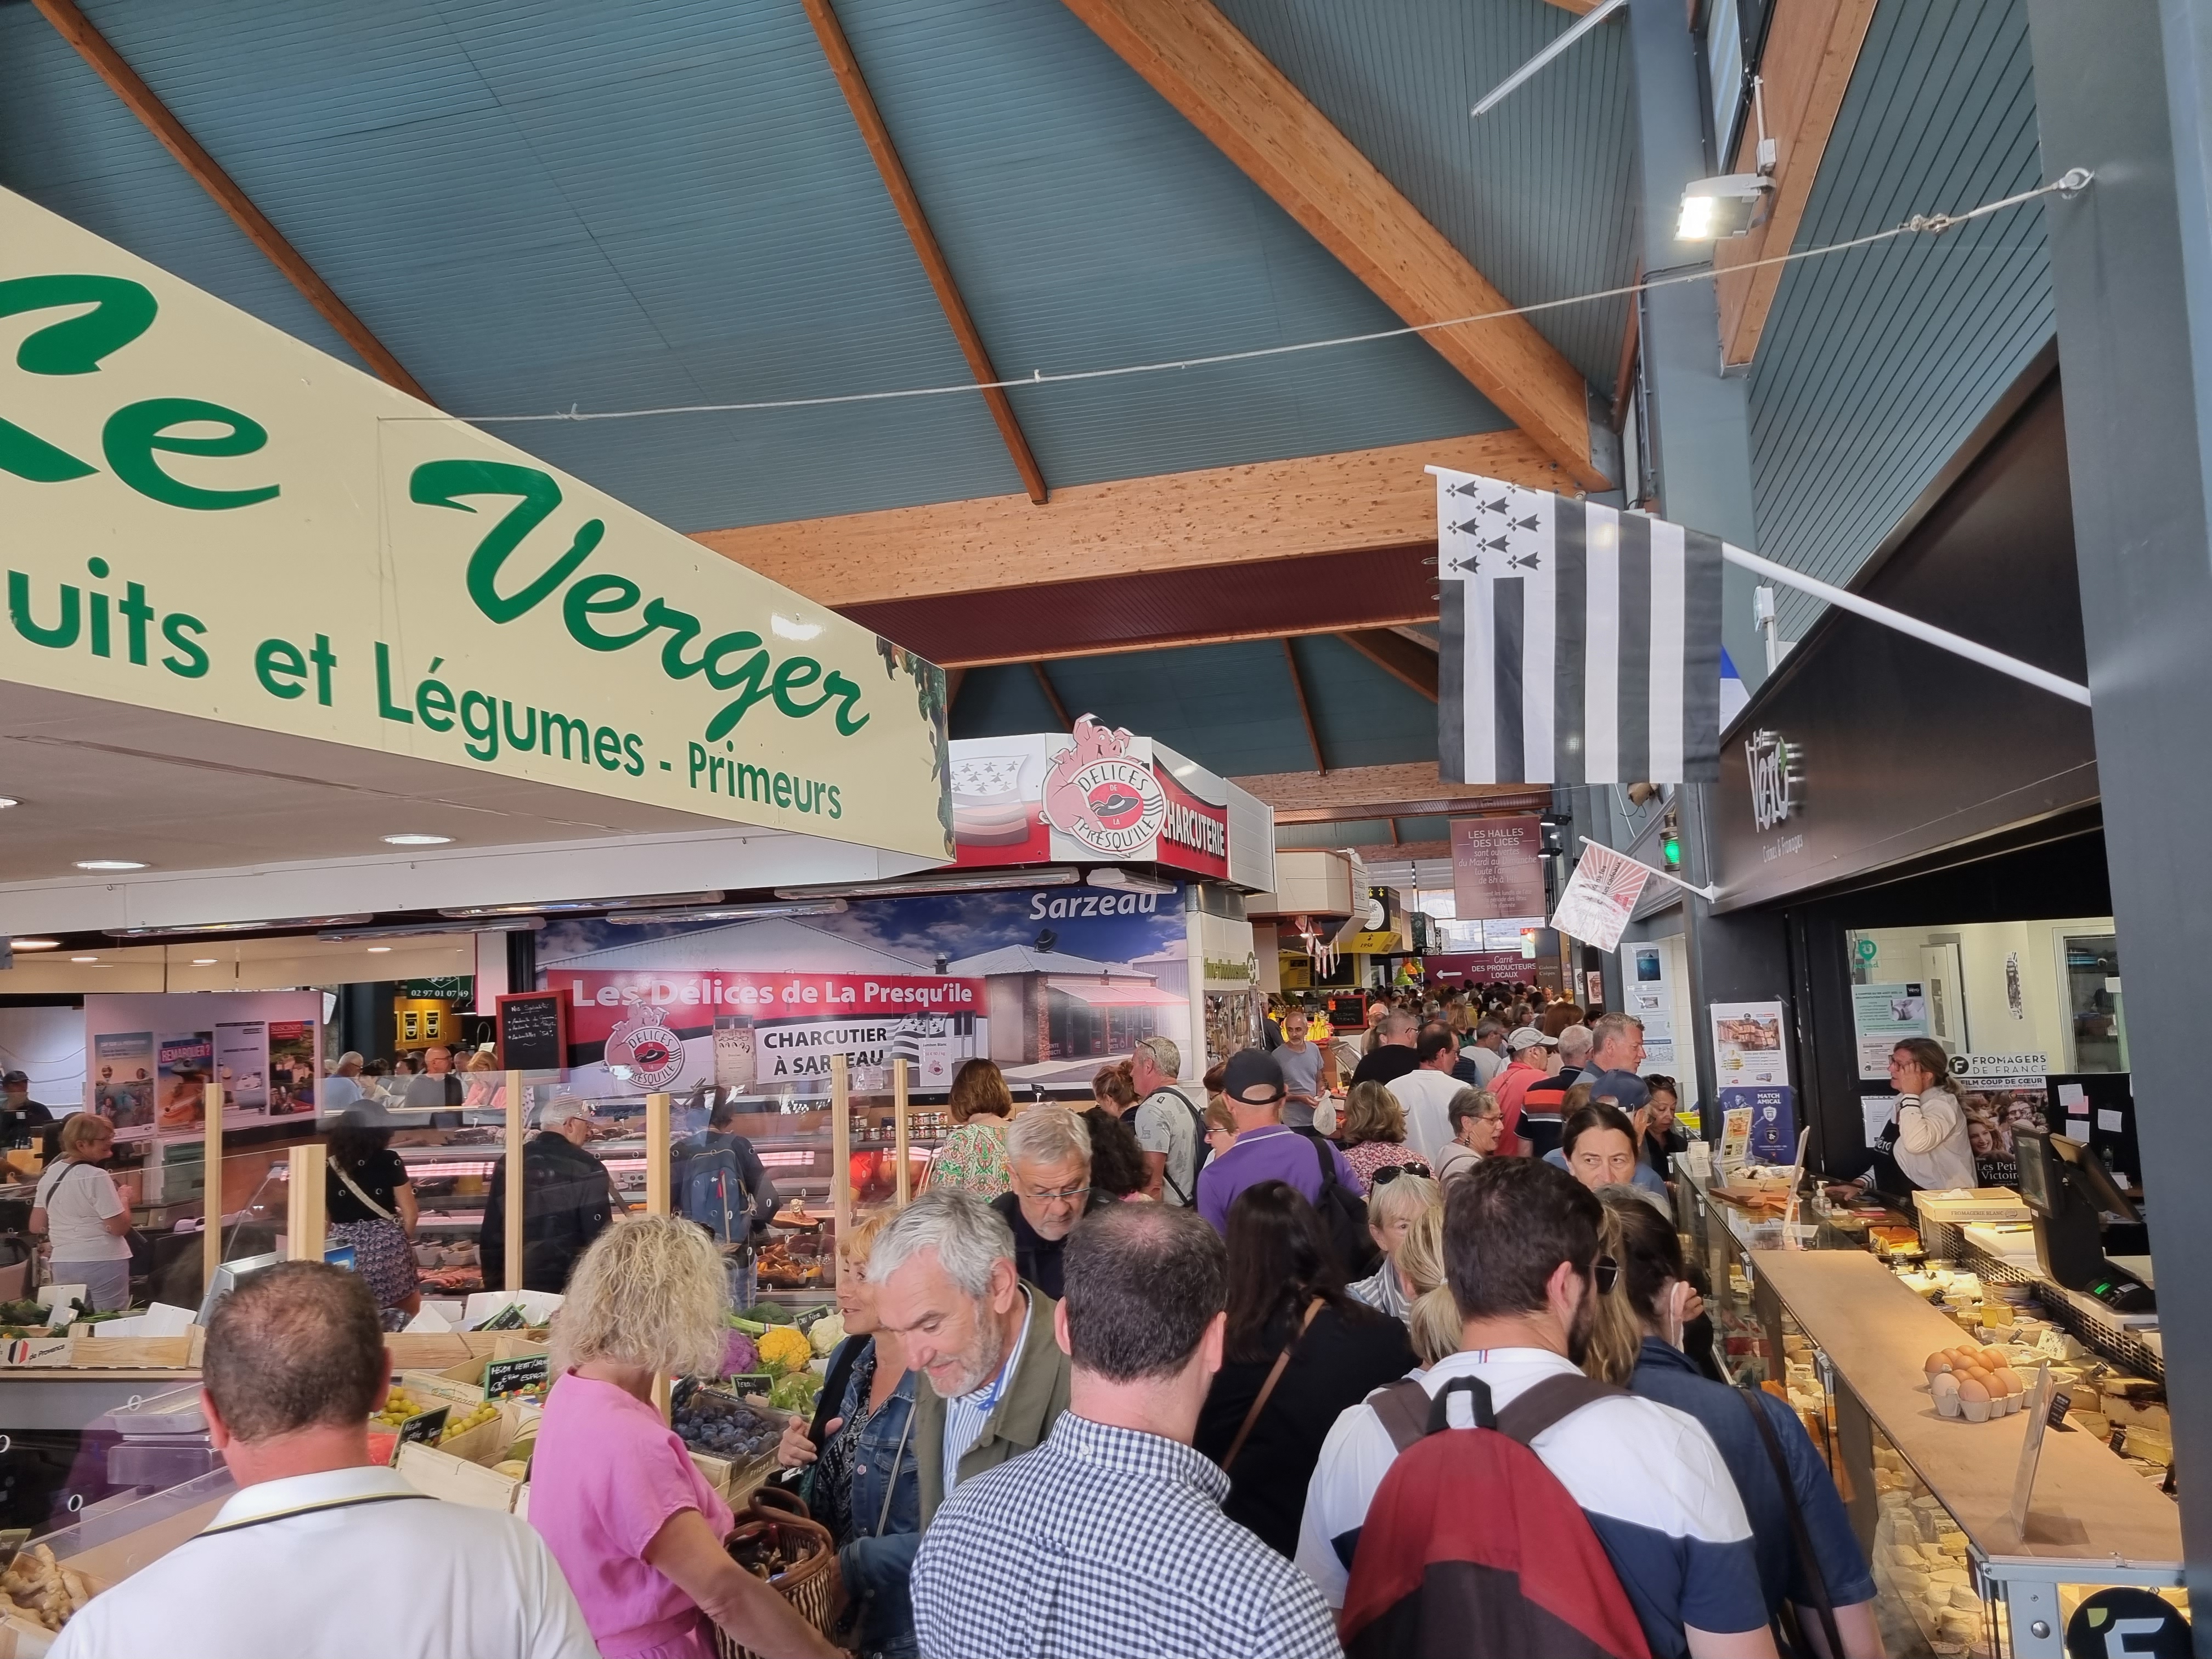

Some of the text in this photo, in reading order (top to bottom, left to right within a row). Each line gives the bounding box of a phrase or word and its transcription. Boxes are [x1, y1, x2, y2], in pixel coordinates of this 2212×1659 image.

[409, 459, 870, 742] Verger
[254, 633, 338, 707] et
[374, 641, 645, 777] Légumes
[687, 740, 843, 820] Primeurs
[1468, 828, 1524, 839] LES HALLES
[1473, 837, 1520, 848] DES LICES
[1474, 847, 1520, 857] sont ouvertes
[1469, 857, 1489, 866] Mardi
[1475, 867, 1492, 876] toute
[1607, 860, 1622, 887] cadeaux
[1029, 891, 1157, 921] Sarzeau
[1494, 955, 1514, 964] Carré
[1487, 963, 1536, 972] PRODUCTEURS
[572, 979, 640, 1007] Les
[651, 977, 775, 1005] Délices
[782, 979, 819, 1005] de
[825, 981, 855, 1003] La
[764, 1027, 888, 1049] CHARCUTIER
[774, 1049, 884, 1076] À SAREAU
[1972, 1055, 2046, 1064] FROMAGERS
[631, 1063, 675, 1085] RESQU'ILE
[1995, 1065, 2047, 1074] FRANCE
[1977, 1161, 2017, 1171] Les Peti
[1981, 1171, 2018, 1180] Victoir
